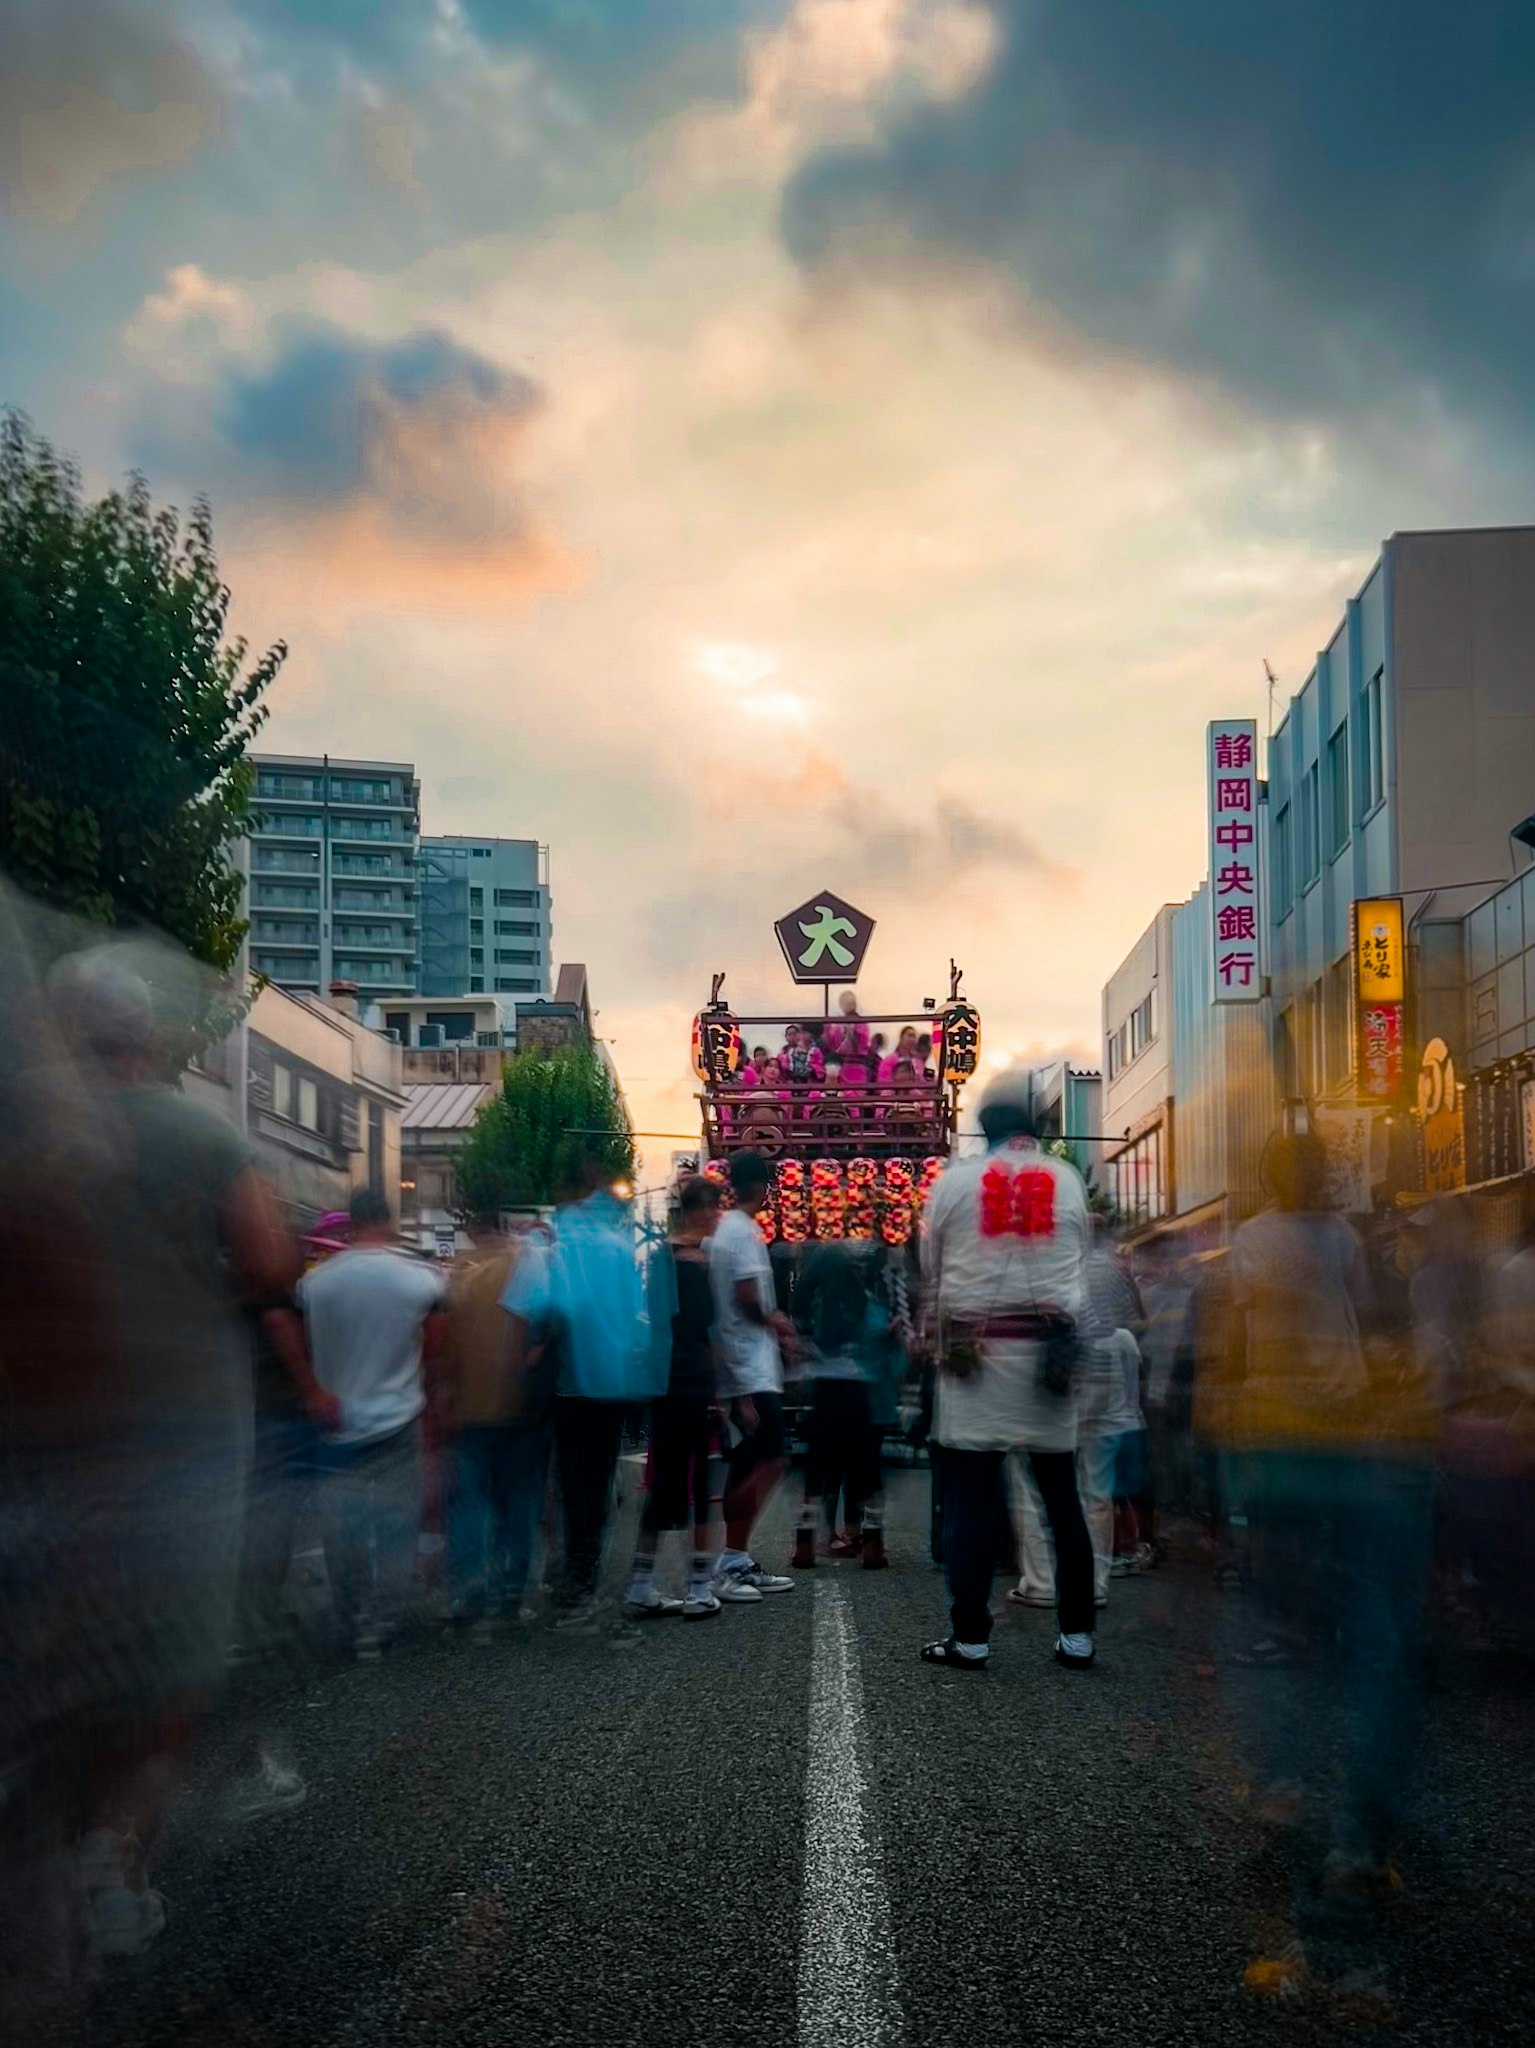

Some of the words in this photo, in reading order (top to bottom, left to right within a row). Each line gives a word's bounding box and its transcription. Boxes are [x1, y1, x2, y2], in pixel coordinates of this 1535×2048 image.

[797, 905, 858, 968] 大
[1215, 733, 1255, 986] 静岡中央銀行
